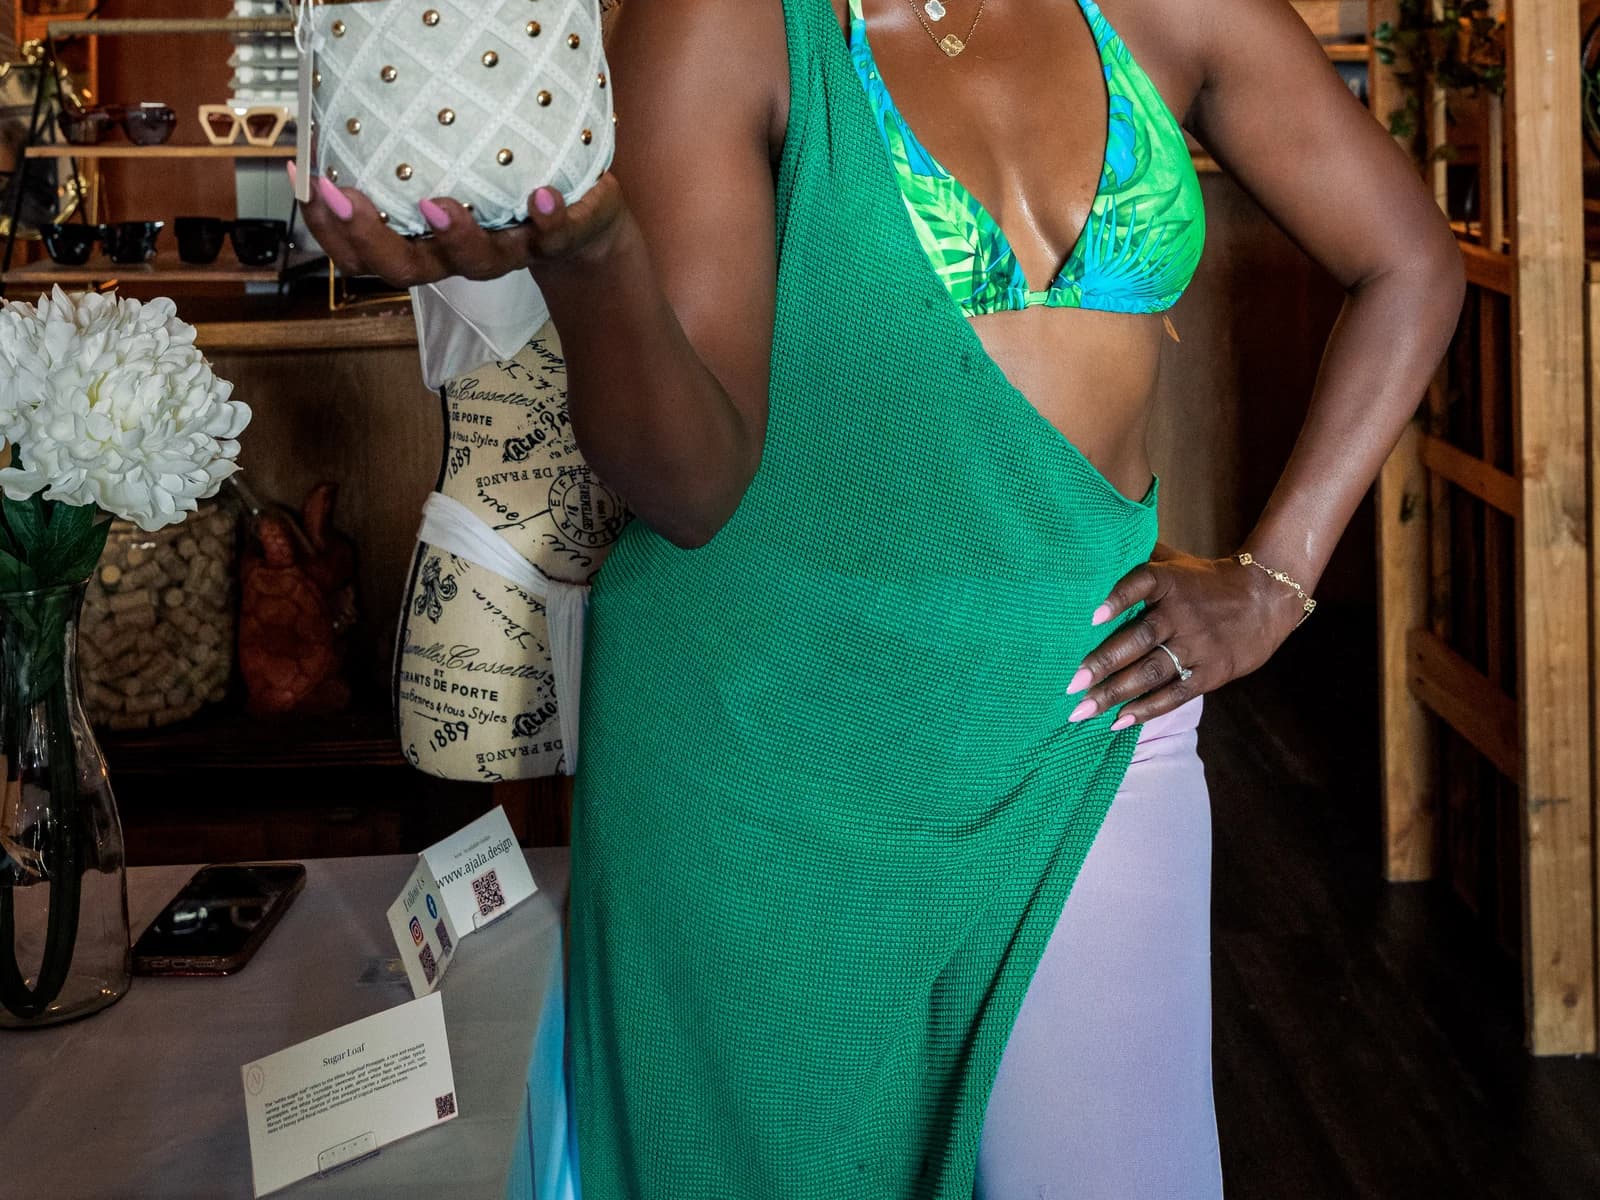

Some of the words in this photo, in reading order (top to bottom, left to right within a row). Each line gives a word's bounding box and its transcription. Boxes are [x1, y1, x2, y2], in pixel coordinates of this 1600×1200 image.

[462, 412, 493, 426] PORTE
[471, 431, 499, 448] Styles
[448, 447, 471, 480] 1889
[475, 470, 528, 488] FRANCE
[446, 644, 546, 681] Crossettes
[433, 679, 447, 693] DE
[451, 684, 499, 702] PORTE
[469, 707, 508, 725] Styles
[429, 721, 469, 752] 1889
[475, 745, 536, 764] FRANCE
[435, 837, 513, 889] www.ajala.design
[322, 1048, 346, 1067] Sugar
[347, 1042, 366, 1057] Loaf
